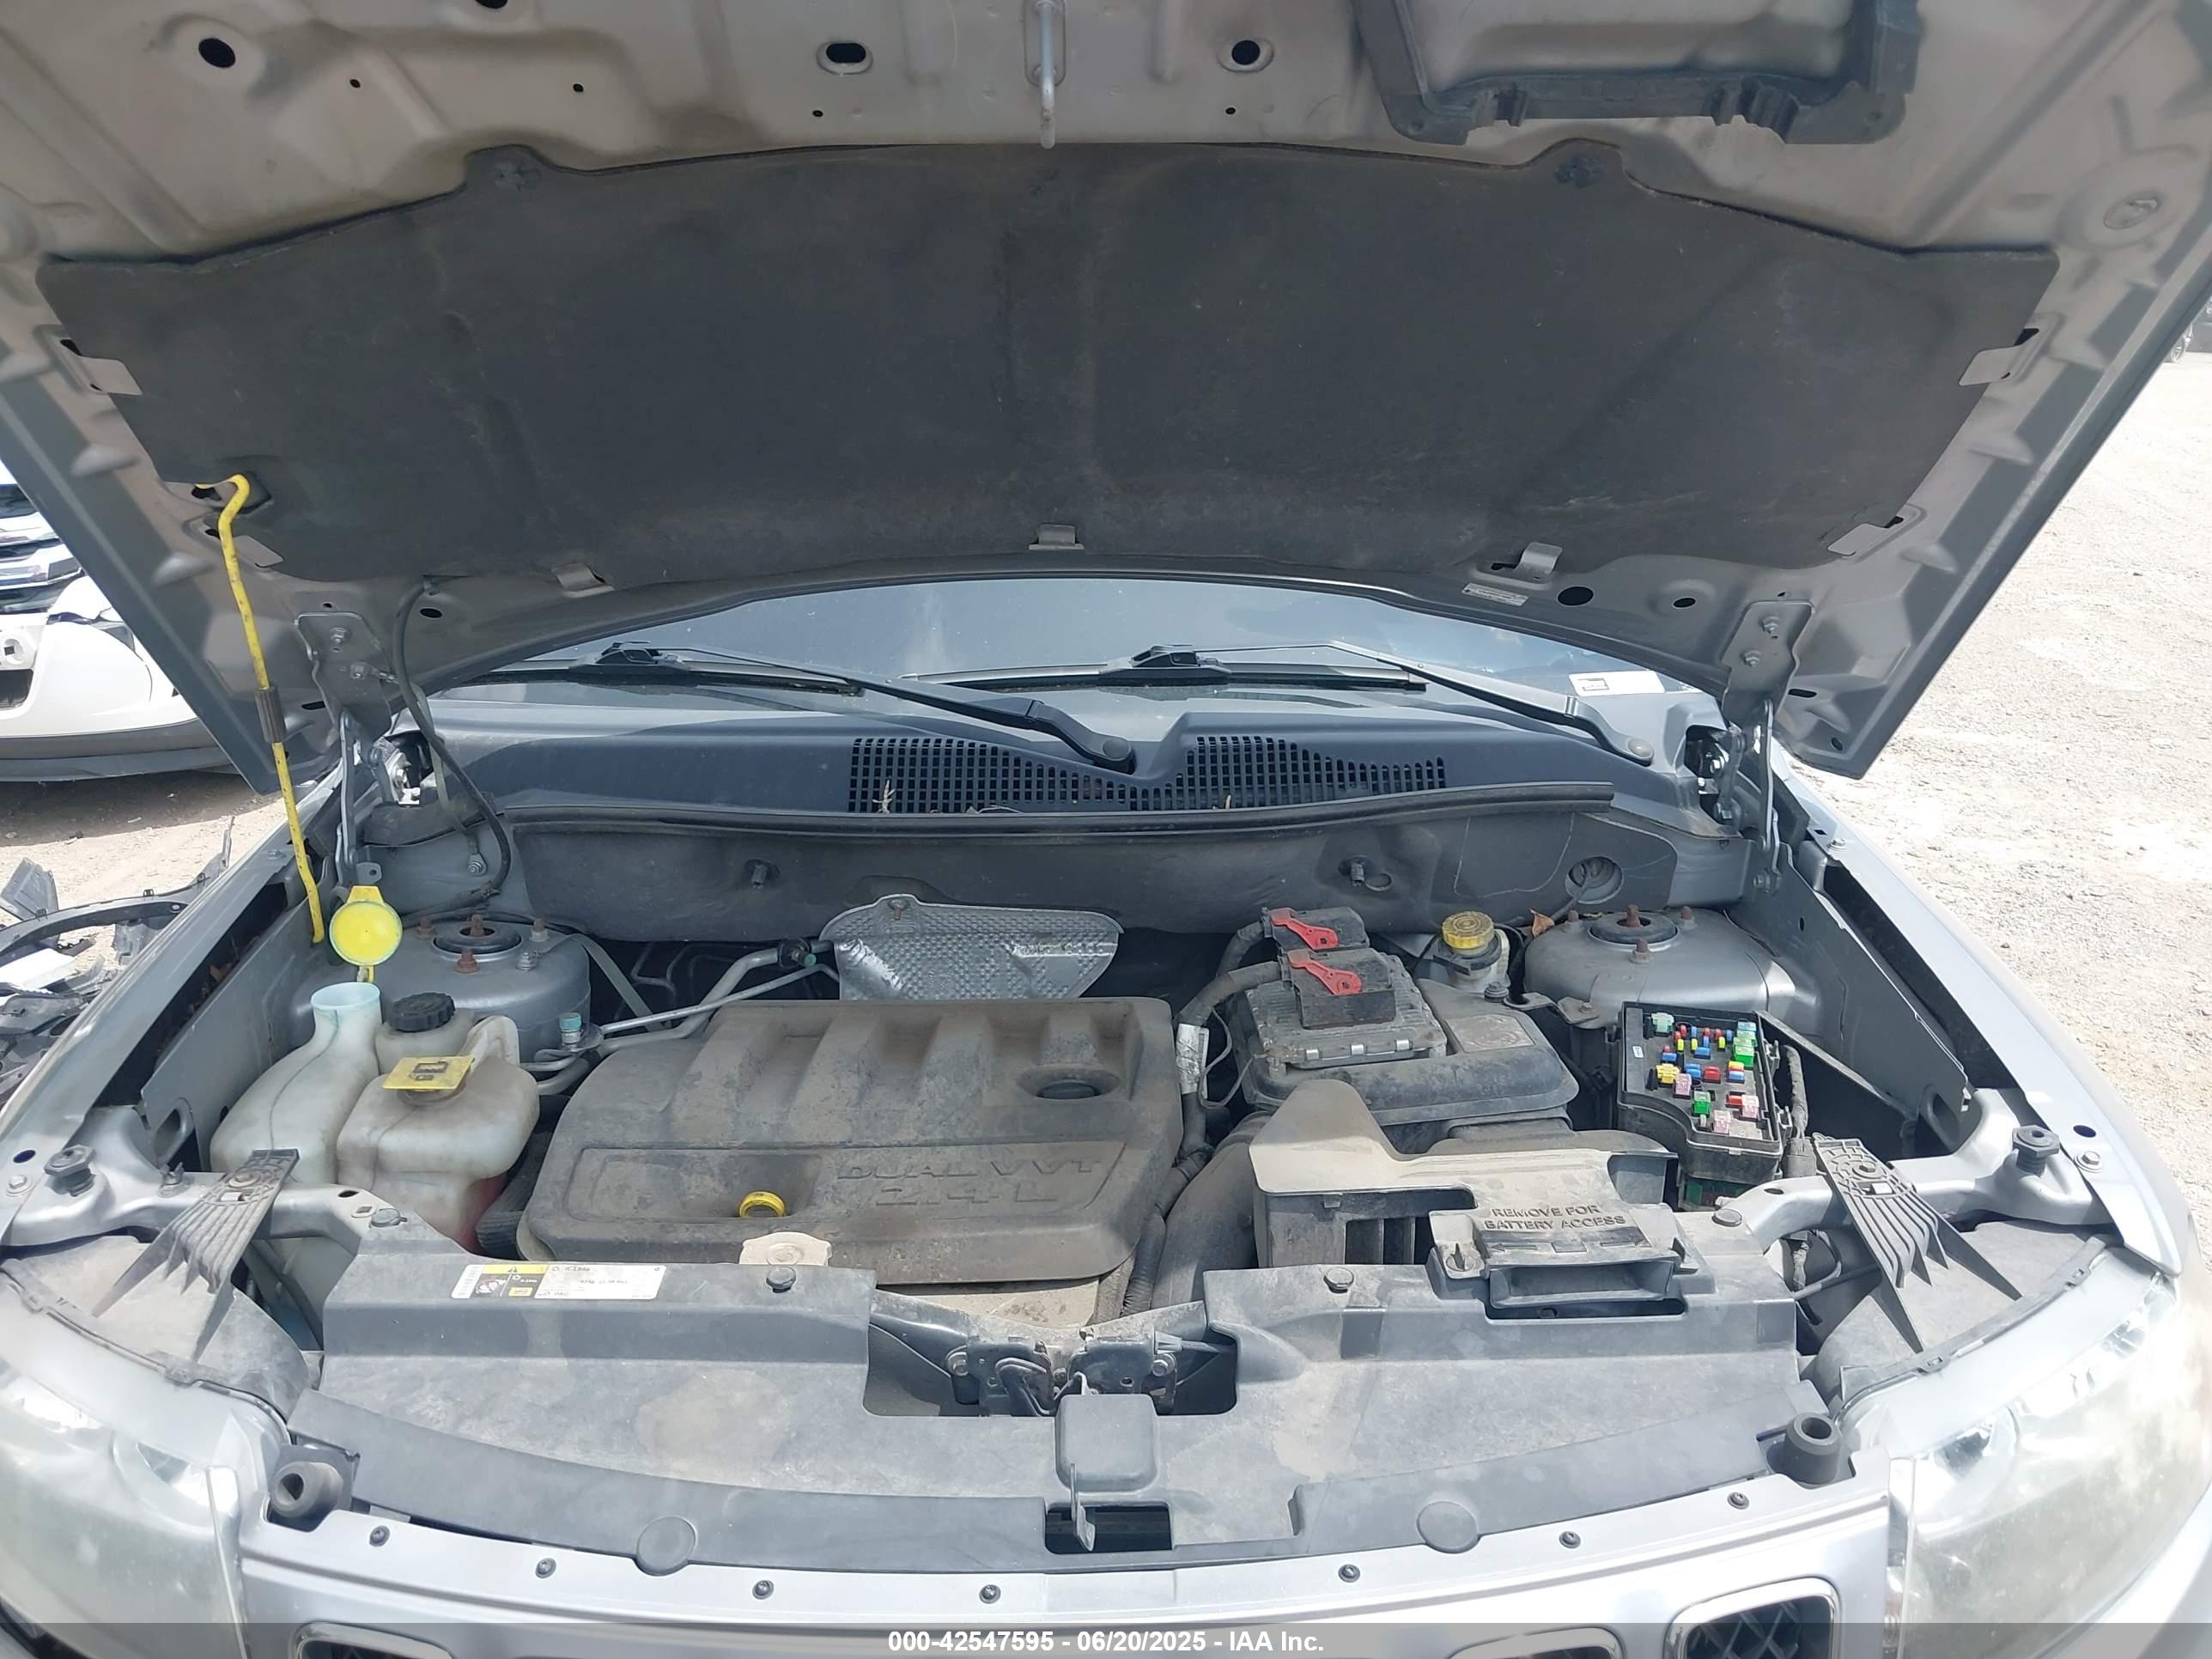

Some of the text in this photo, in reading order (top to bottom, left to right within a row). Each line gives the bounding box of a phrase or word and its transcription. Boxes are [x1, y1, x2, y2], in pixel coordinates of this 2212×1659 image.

[837, 1159, 1103, 1180] DUAL VVT
[1492, 1205, 1601, 1217] REMOVE FOR
[1484, 1216, 1626, 1230] BATTERY ACCESS
